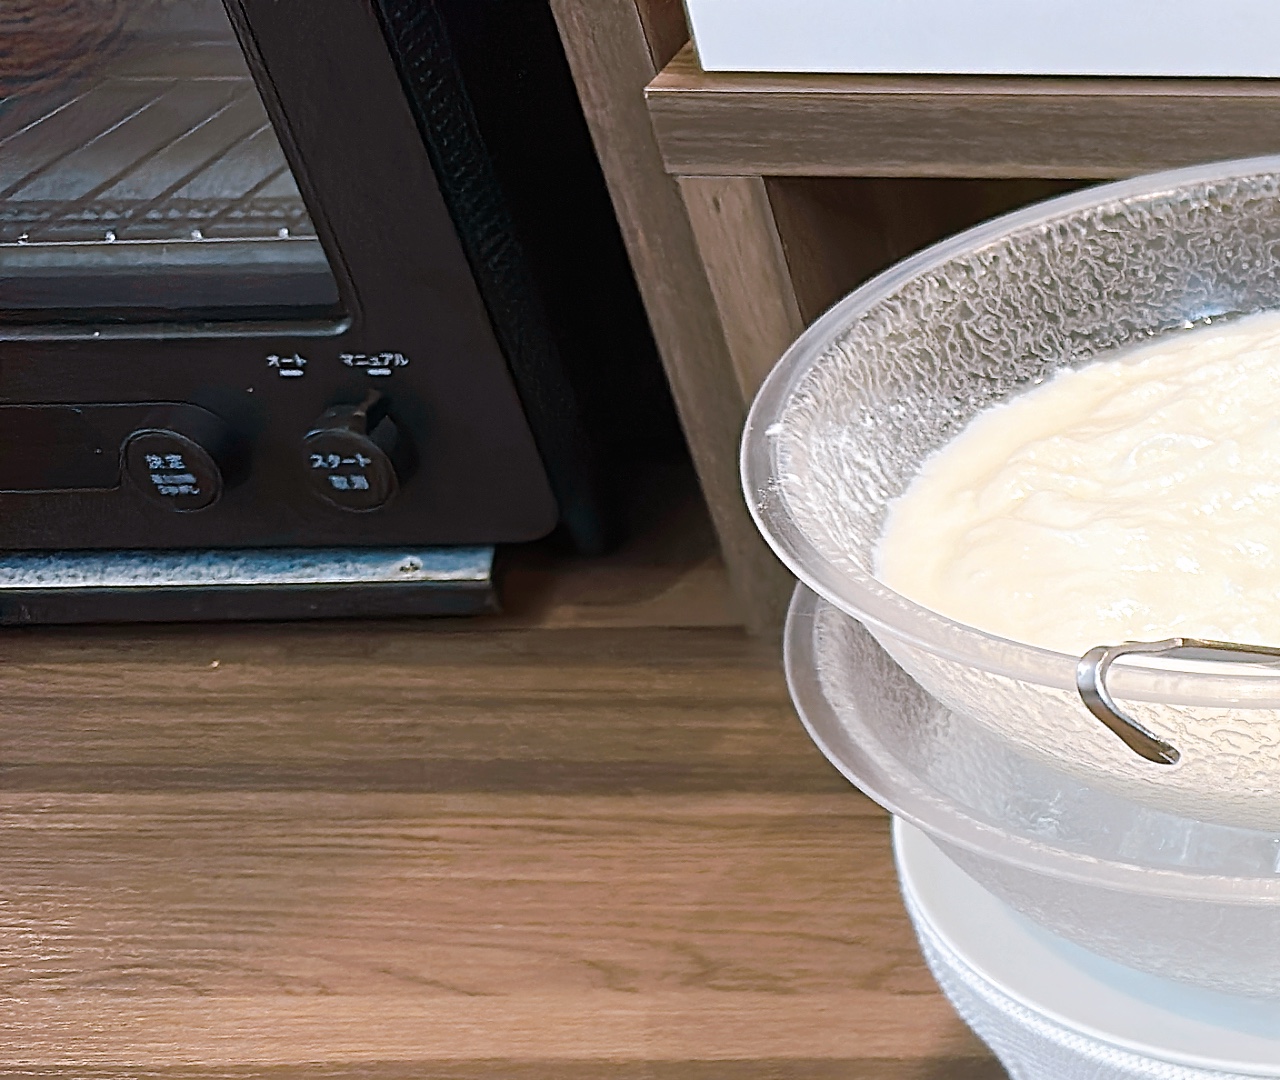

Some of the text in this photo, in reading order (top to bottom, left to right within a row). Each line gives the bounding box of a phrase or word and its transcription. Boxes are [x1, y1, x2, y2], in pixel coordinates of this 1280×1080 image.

[266, 354, 307, 367] オート
[339, 352, 409, 367] マニュアル
[310, 453, 371, 468] スタート
